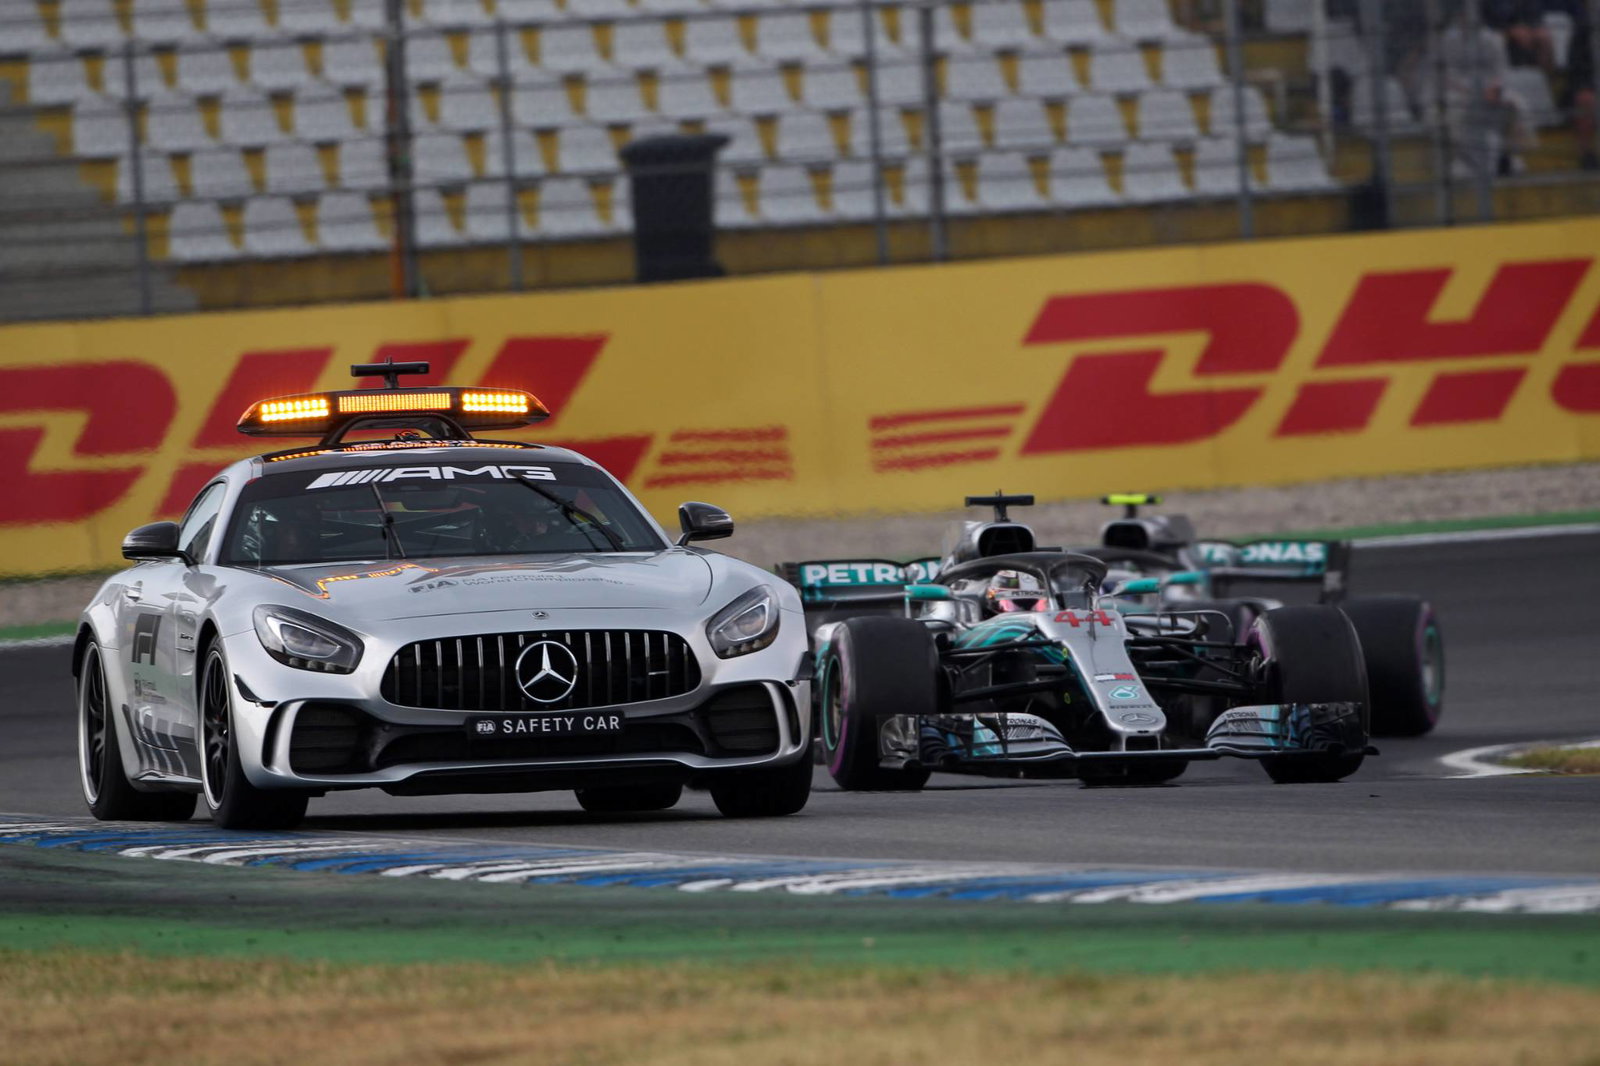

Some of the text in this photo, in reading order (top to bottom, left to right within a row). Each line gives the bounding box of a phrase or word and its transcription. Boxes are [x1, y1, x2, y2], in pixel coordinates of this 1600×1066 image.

[1018, 256, 1600, 457] DH
[382, 465, 557, 482] AMG
[1055, 608, 1115, 627] 44
[502, 718, 574, 734] SAFETY
[583, 716, 620, 731] CAR
